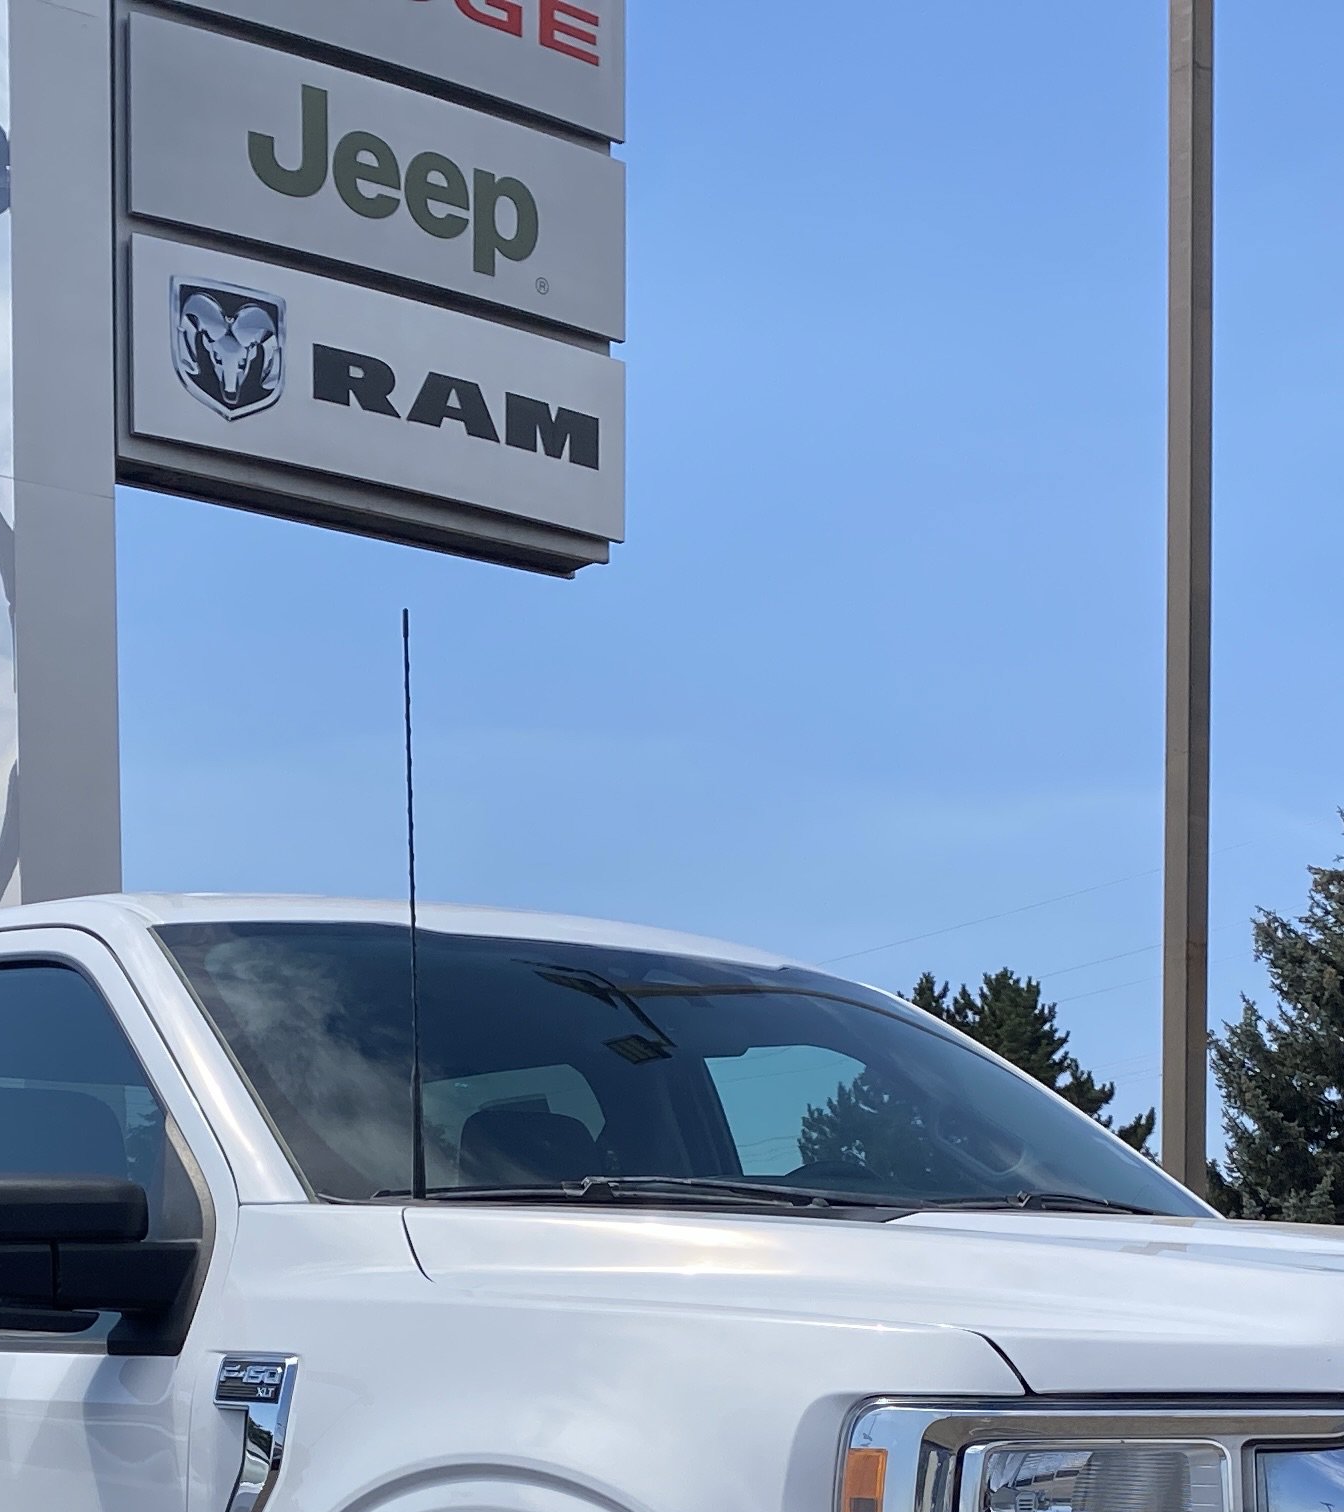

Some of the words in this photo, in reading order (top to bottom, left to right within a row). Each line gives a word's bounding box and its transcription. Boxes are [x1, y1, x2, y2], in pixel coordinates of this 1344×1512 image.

[247, 84, 539, 277] Jeep
[312, 343, 600, 471] RAM
[219, 1365, 283, 1385] F-150
[256, 1387, 275, 1398] XLT
